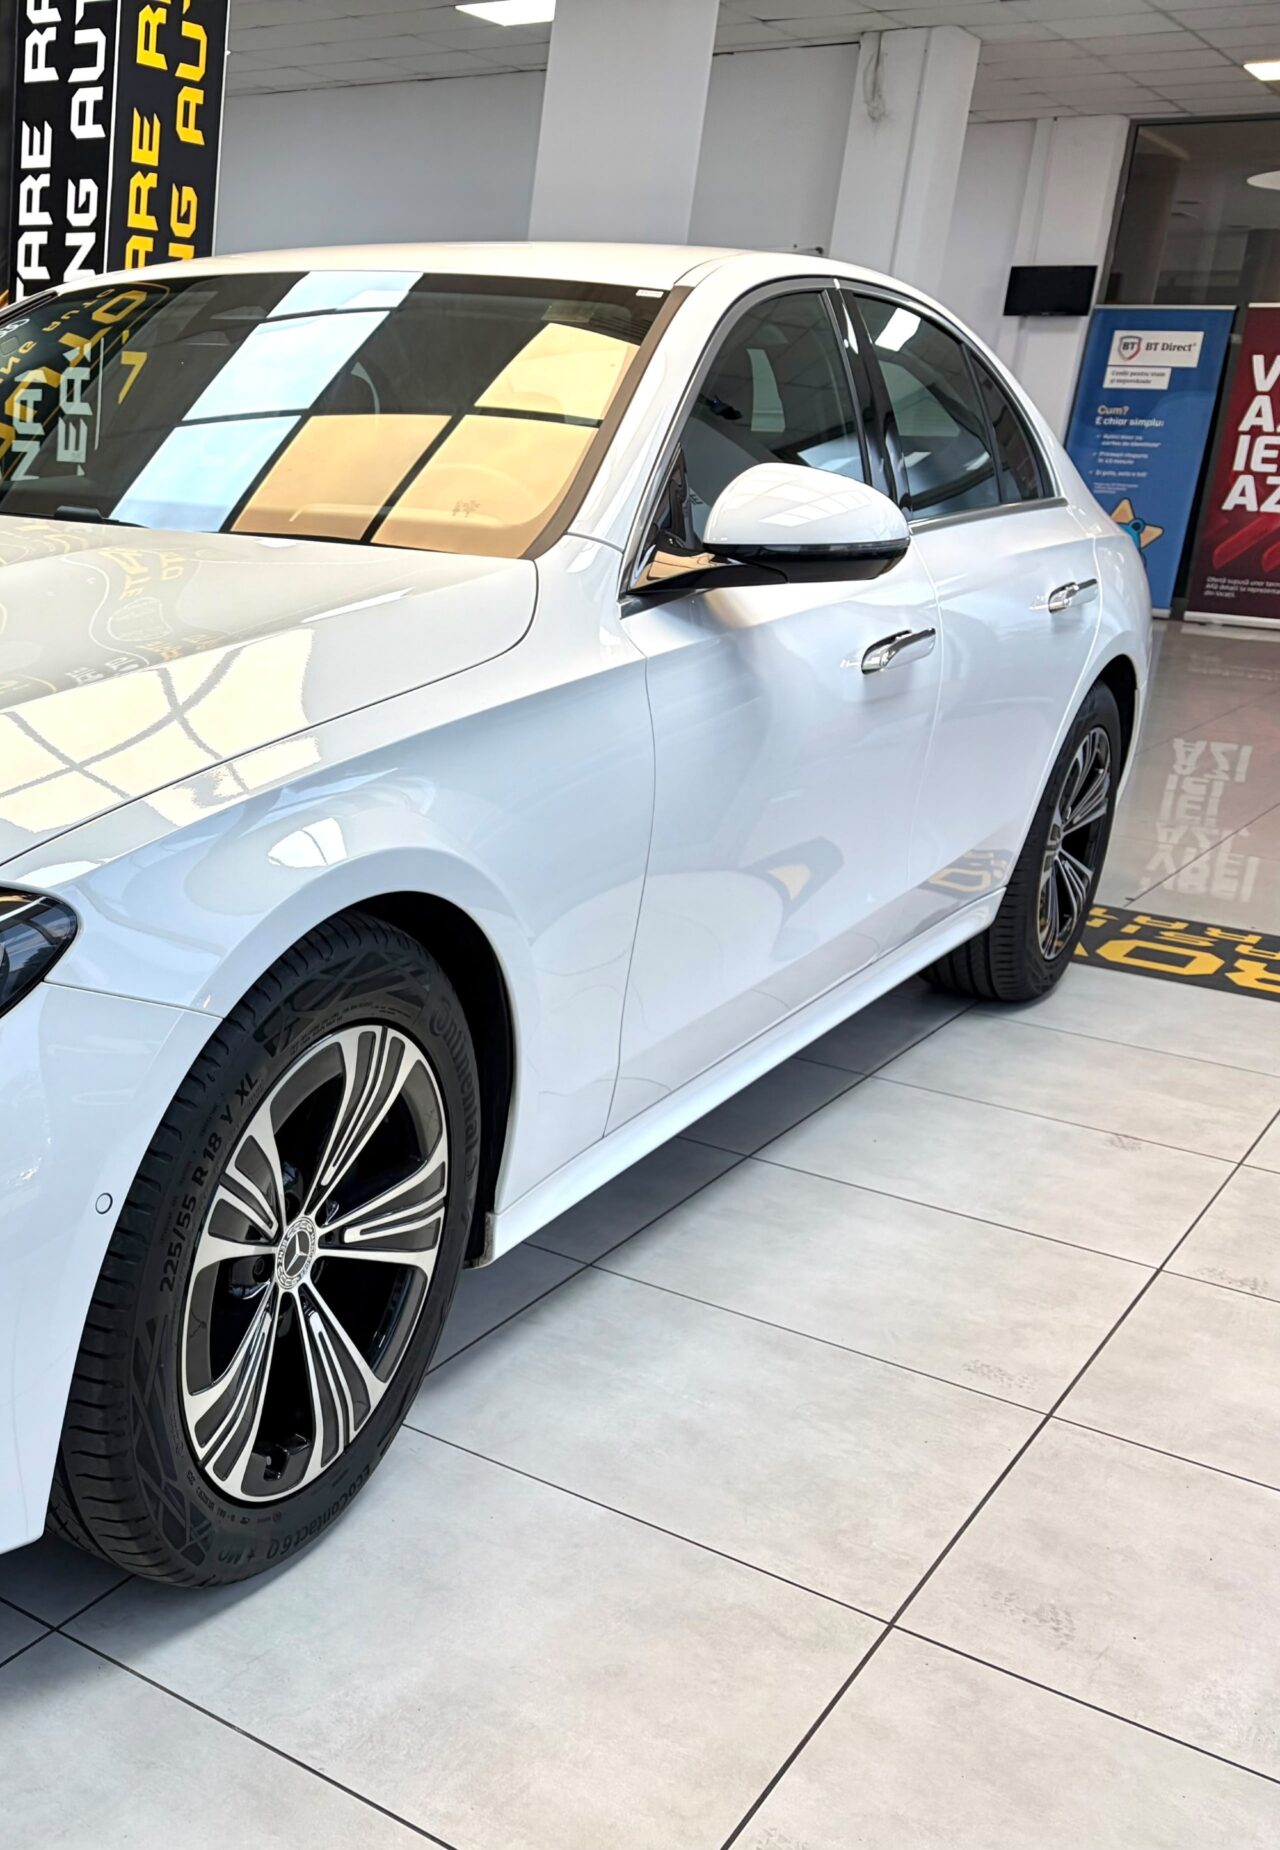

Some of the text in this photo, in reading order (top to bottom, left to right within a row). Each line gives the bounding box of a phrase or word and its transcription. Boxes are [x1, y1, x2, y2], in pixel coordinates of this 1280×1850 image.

[1145, 342, 1160, 351] BT
[1098, 405, 1129, 415] Cum?
[1095, 417, 1102, 425] E
[160, 1192, 197, 1292] 225/55
[192, 1165, 209, 1187] R
[203, 1132, 222, 1162] 18
[234, 1072, 260, 1105] XL
